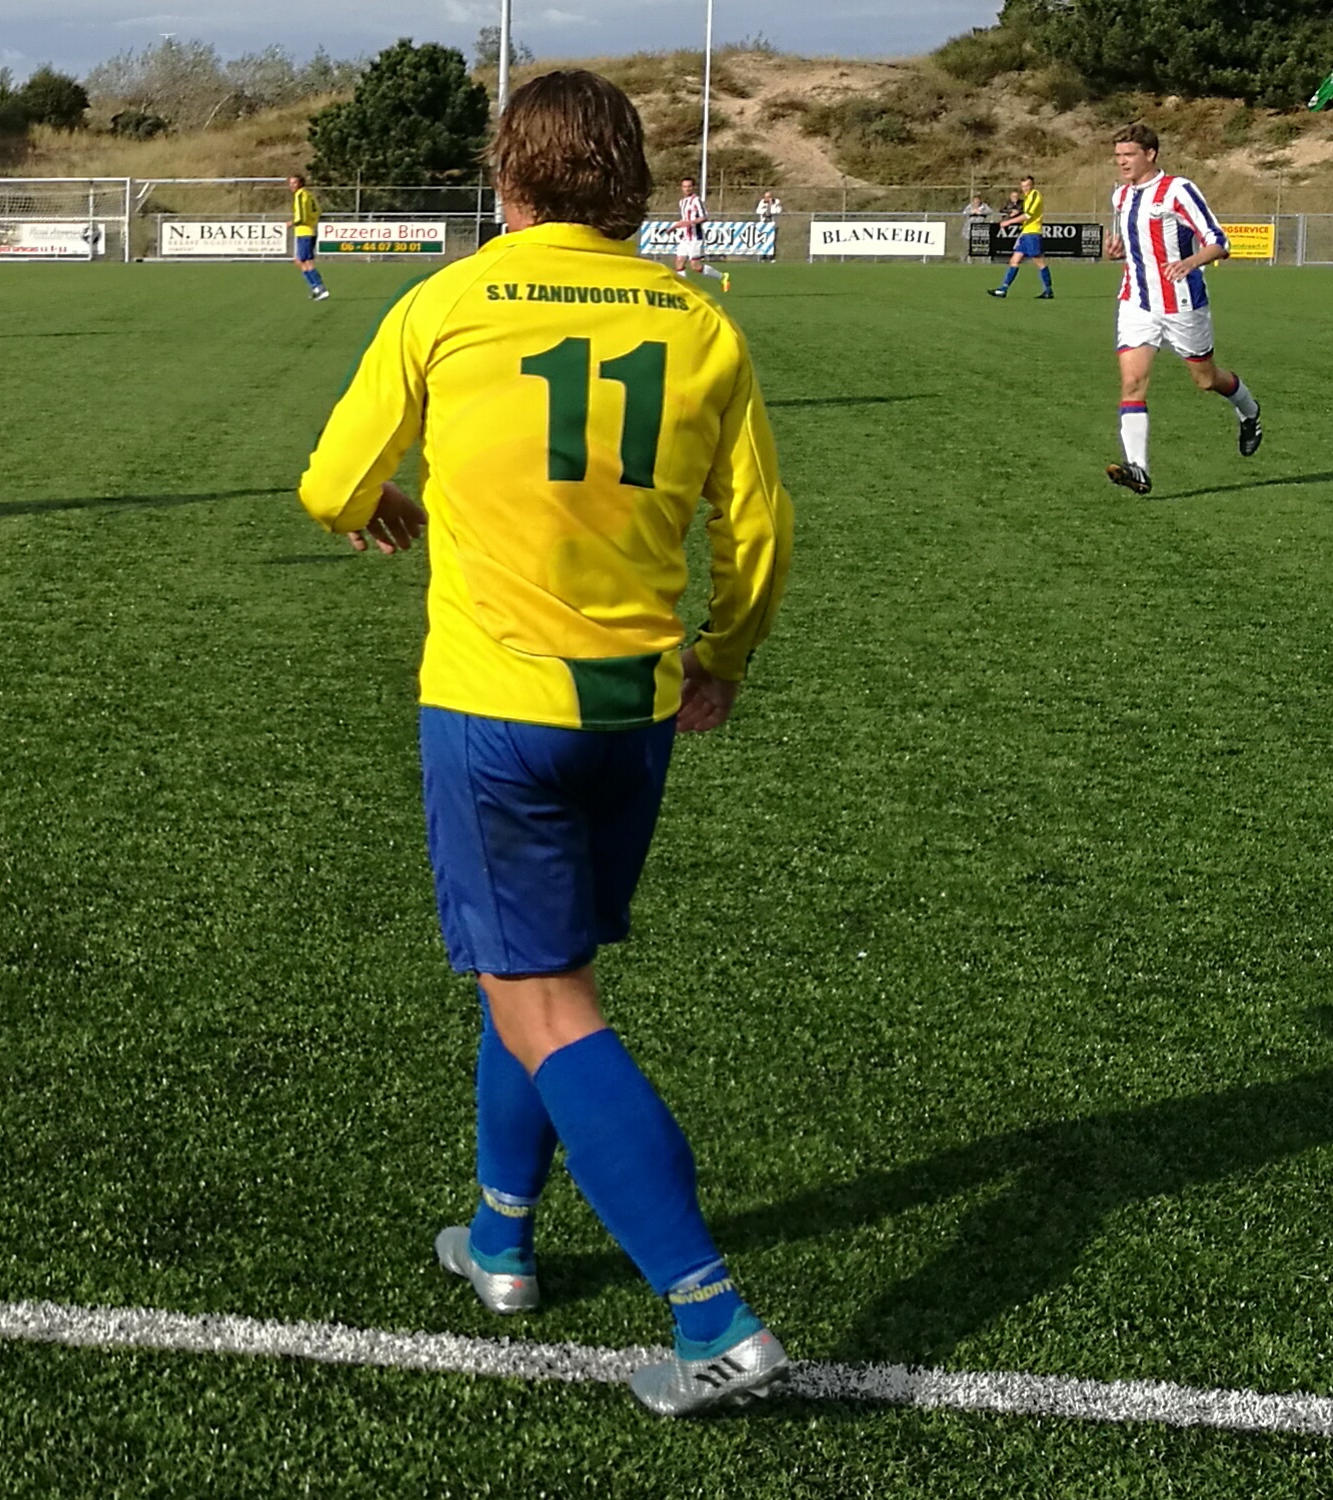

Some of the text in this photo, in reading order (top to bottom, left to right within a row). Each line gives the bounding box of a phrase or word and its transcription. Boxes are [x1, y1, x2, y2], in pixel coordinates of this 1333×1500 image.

[169, 224, 284, 240] N. BAKELS
[324, 224, 438, 239] Pizzeria Bino
[649, 226, 736, 246] KRON
[823, 227, 935, 245] BLANKEBIL
[996, 225, 1077, 239] AZRRO
[340, 242, 355, 251] 06
[362, 242, 376, 251] 44
[377, 242, 392, 251] 07
[394, 242, 407, 251] 30
[486, 284, 523, 301] S.V.
[526, 284, 641, 304] ZANDVOORT
[520, 336, 668, 490] 11
